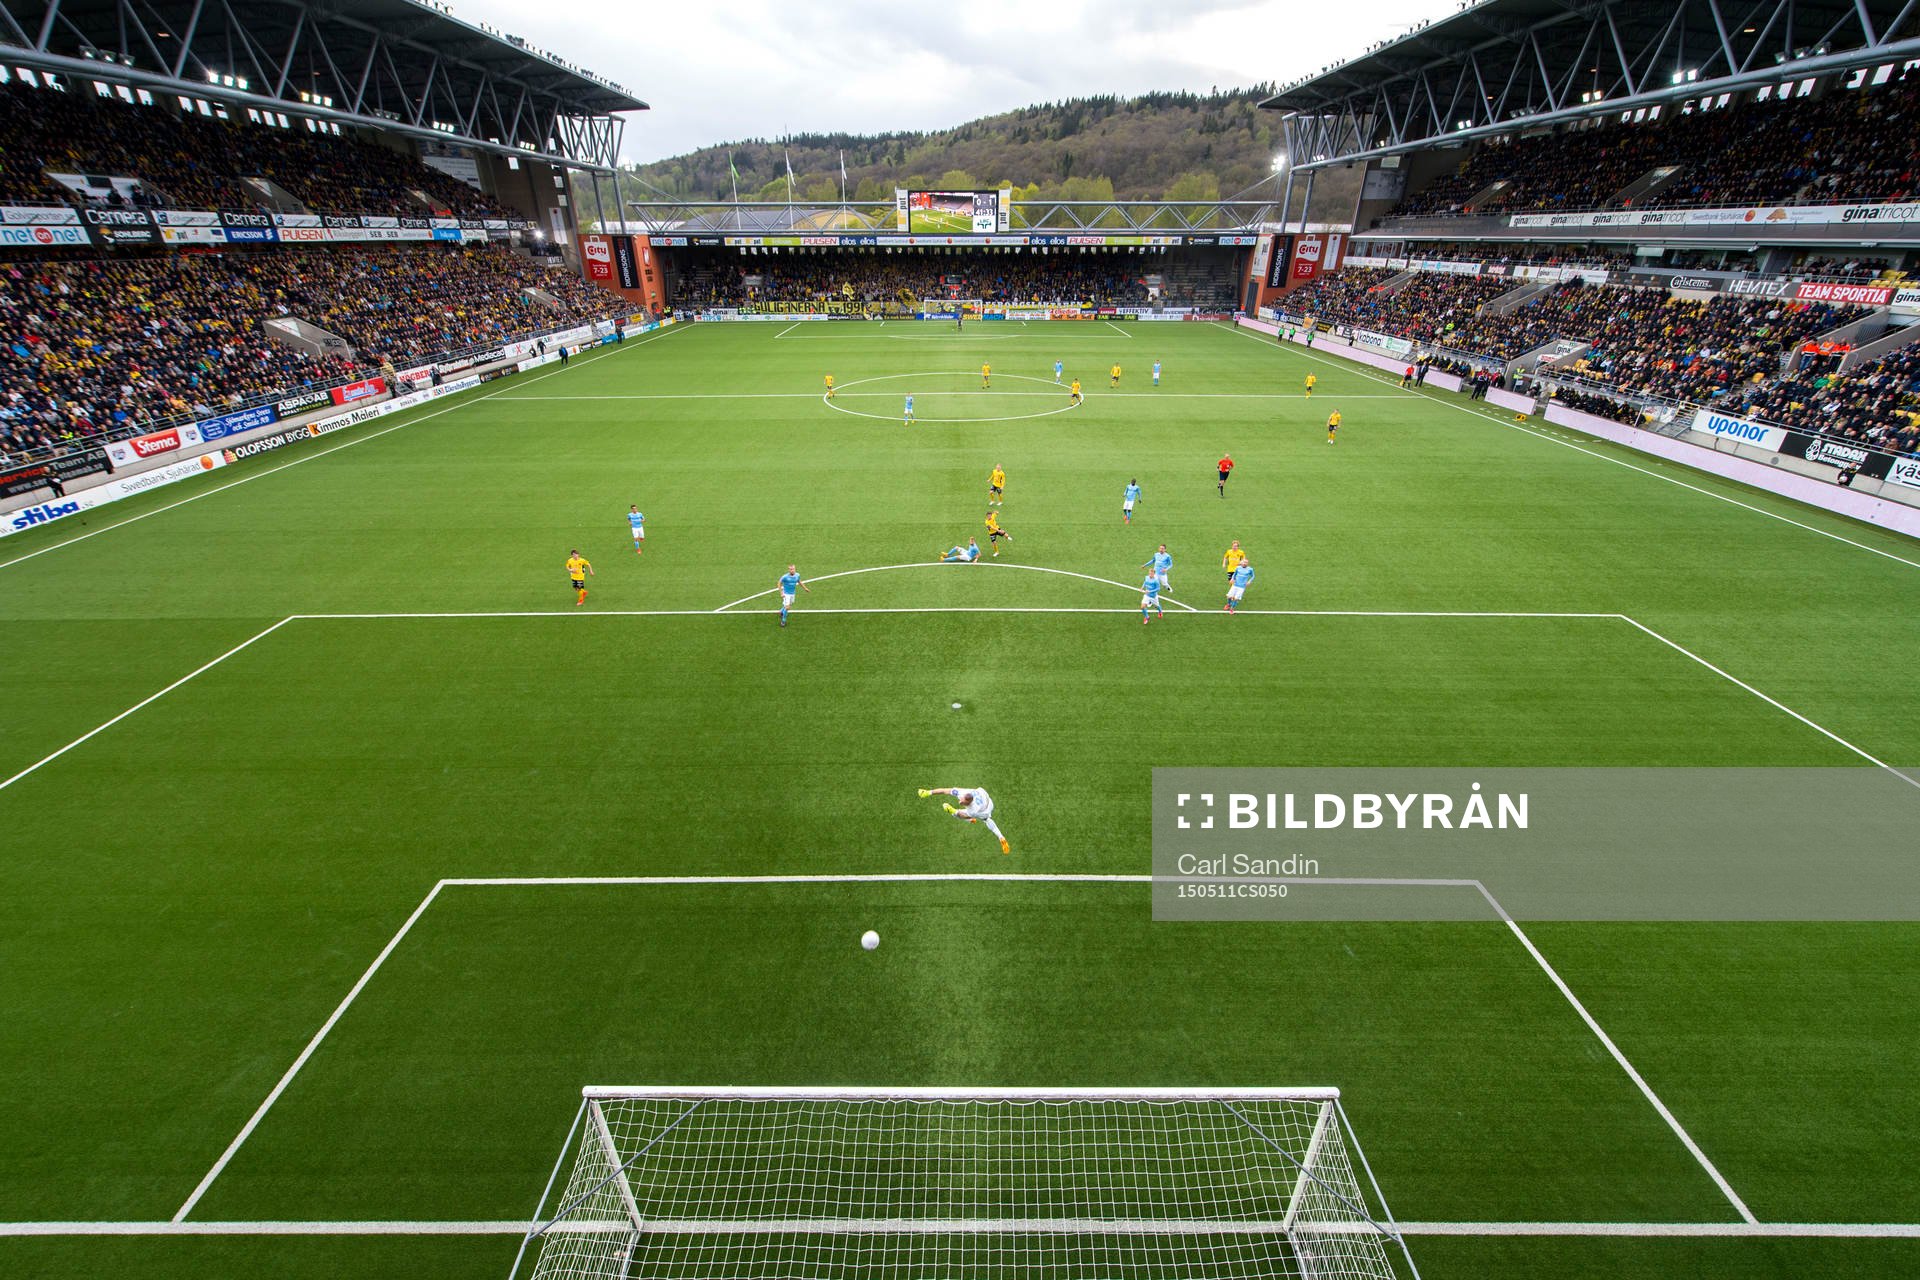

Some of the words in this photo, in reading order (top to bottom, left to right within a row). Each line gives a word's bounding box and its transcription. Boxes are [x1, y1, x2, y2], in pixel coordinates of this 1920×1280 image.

[1842, 204, 1919, 222] ginatricot
[282, 228, 324, 240] PULSEN
[587, 245, 607, 256] City
[1298, 244, 1319, 254] City
[1798, 284, 1832, 299] TEAM
[1831, 287, 1889, 304] SPORTIA
[314, 391, 329, 403] AB
[312, 416, 350, 435] Kimmos
[351, 406, 380, 423] Måleri
[1708, 415, 1770, 442] uponor
[235, 435, 286, 458] OLOFSSON
[286, 427, 311, 443] BYGG
[121, 472, 166, 493] Swedbank
[13, 501, 81, 530] stiba
